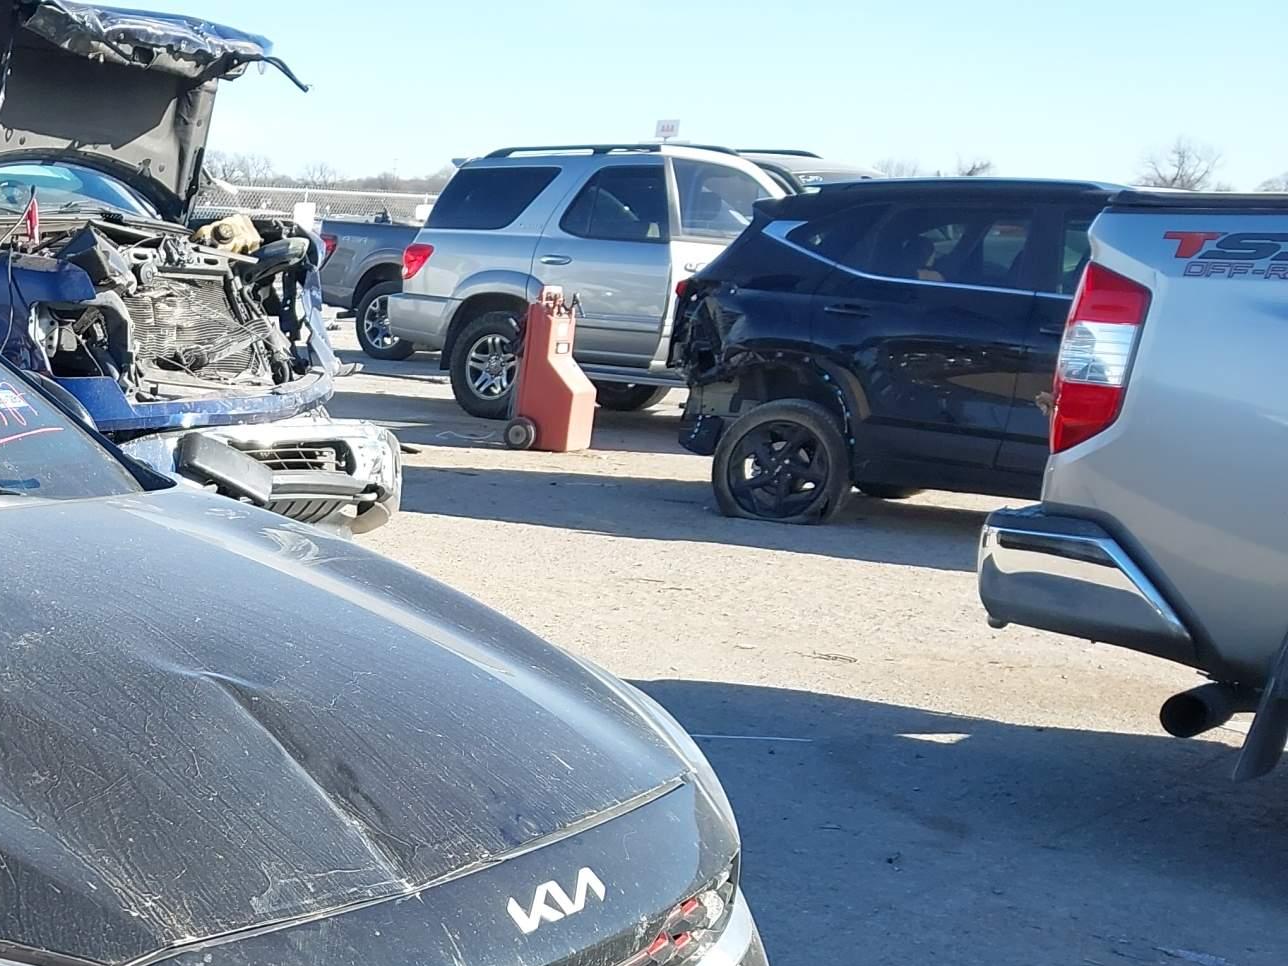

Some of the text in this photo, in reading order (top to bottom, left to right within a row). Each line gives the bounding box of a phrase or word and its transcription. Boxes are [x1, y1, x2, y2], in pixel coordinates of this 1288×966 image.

[1163, 231, 1288, 261] TS
[1183, 261, 1288, 280] OFF-R
[506, 866, 606, 934] KIA
